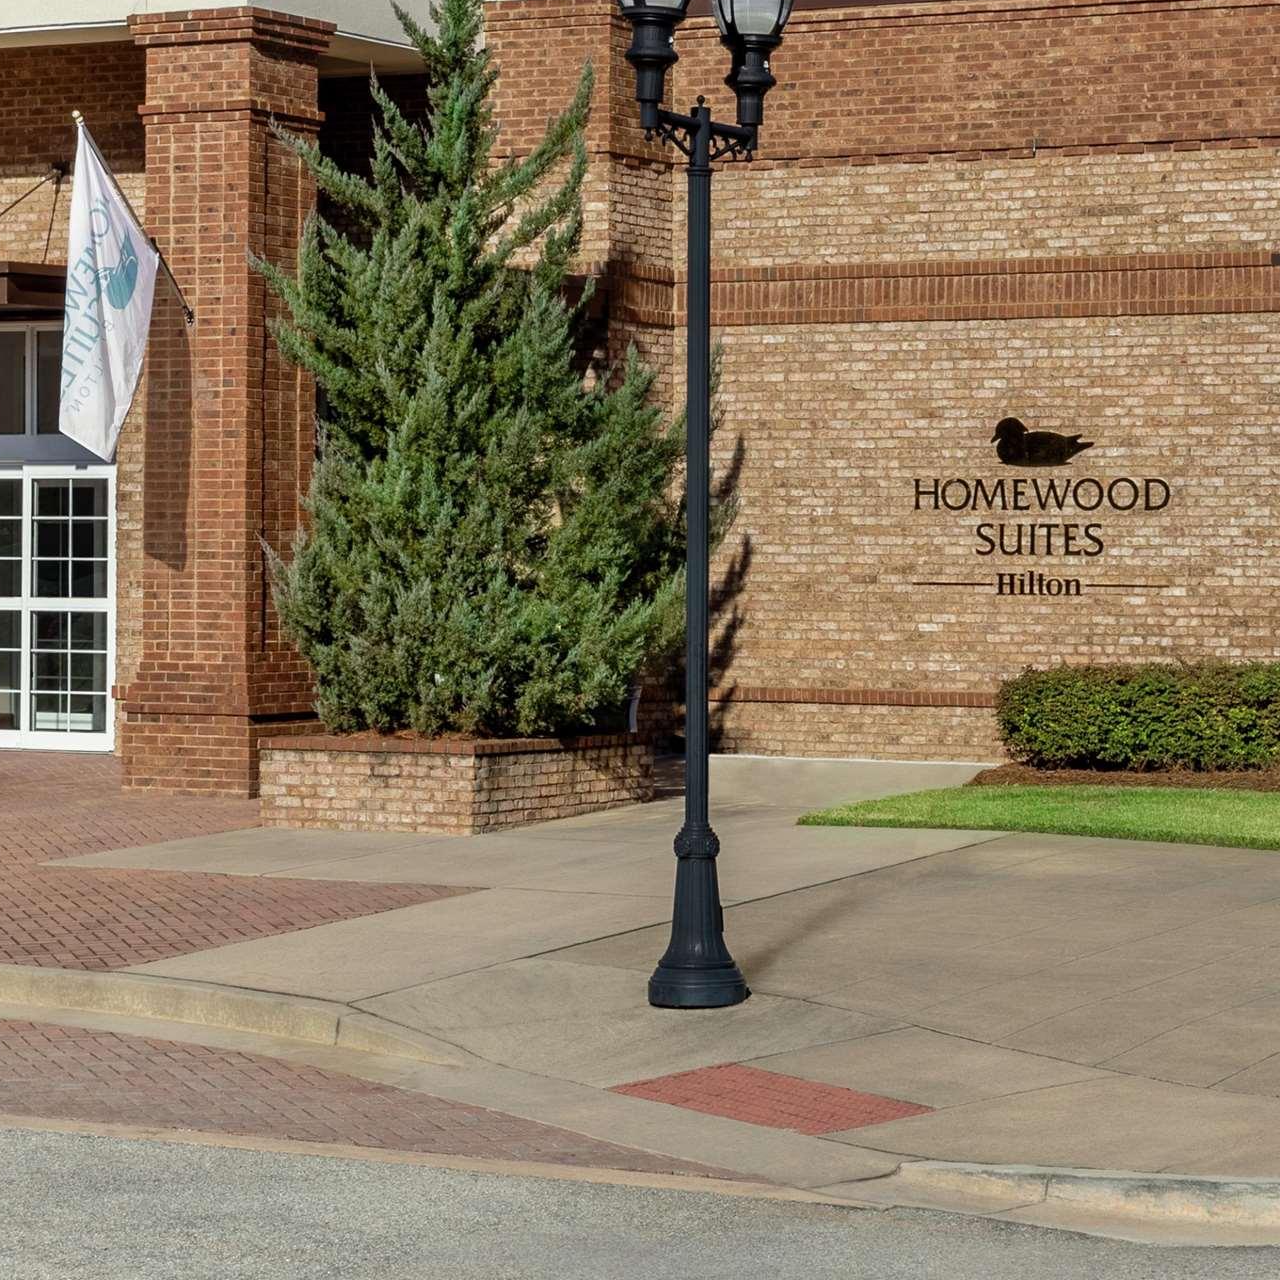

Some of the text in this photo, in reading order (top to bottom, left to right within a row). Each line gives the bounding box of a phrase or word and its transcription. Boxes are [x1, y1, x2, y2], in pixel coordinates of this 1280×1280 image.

[914, 478, 1170, 511] HOMEWOOD
[976, 523, 1104, 556] SUITES
[996, 570, 1082, 596] Hilton
